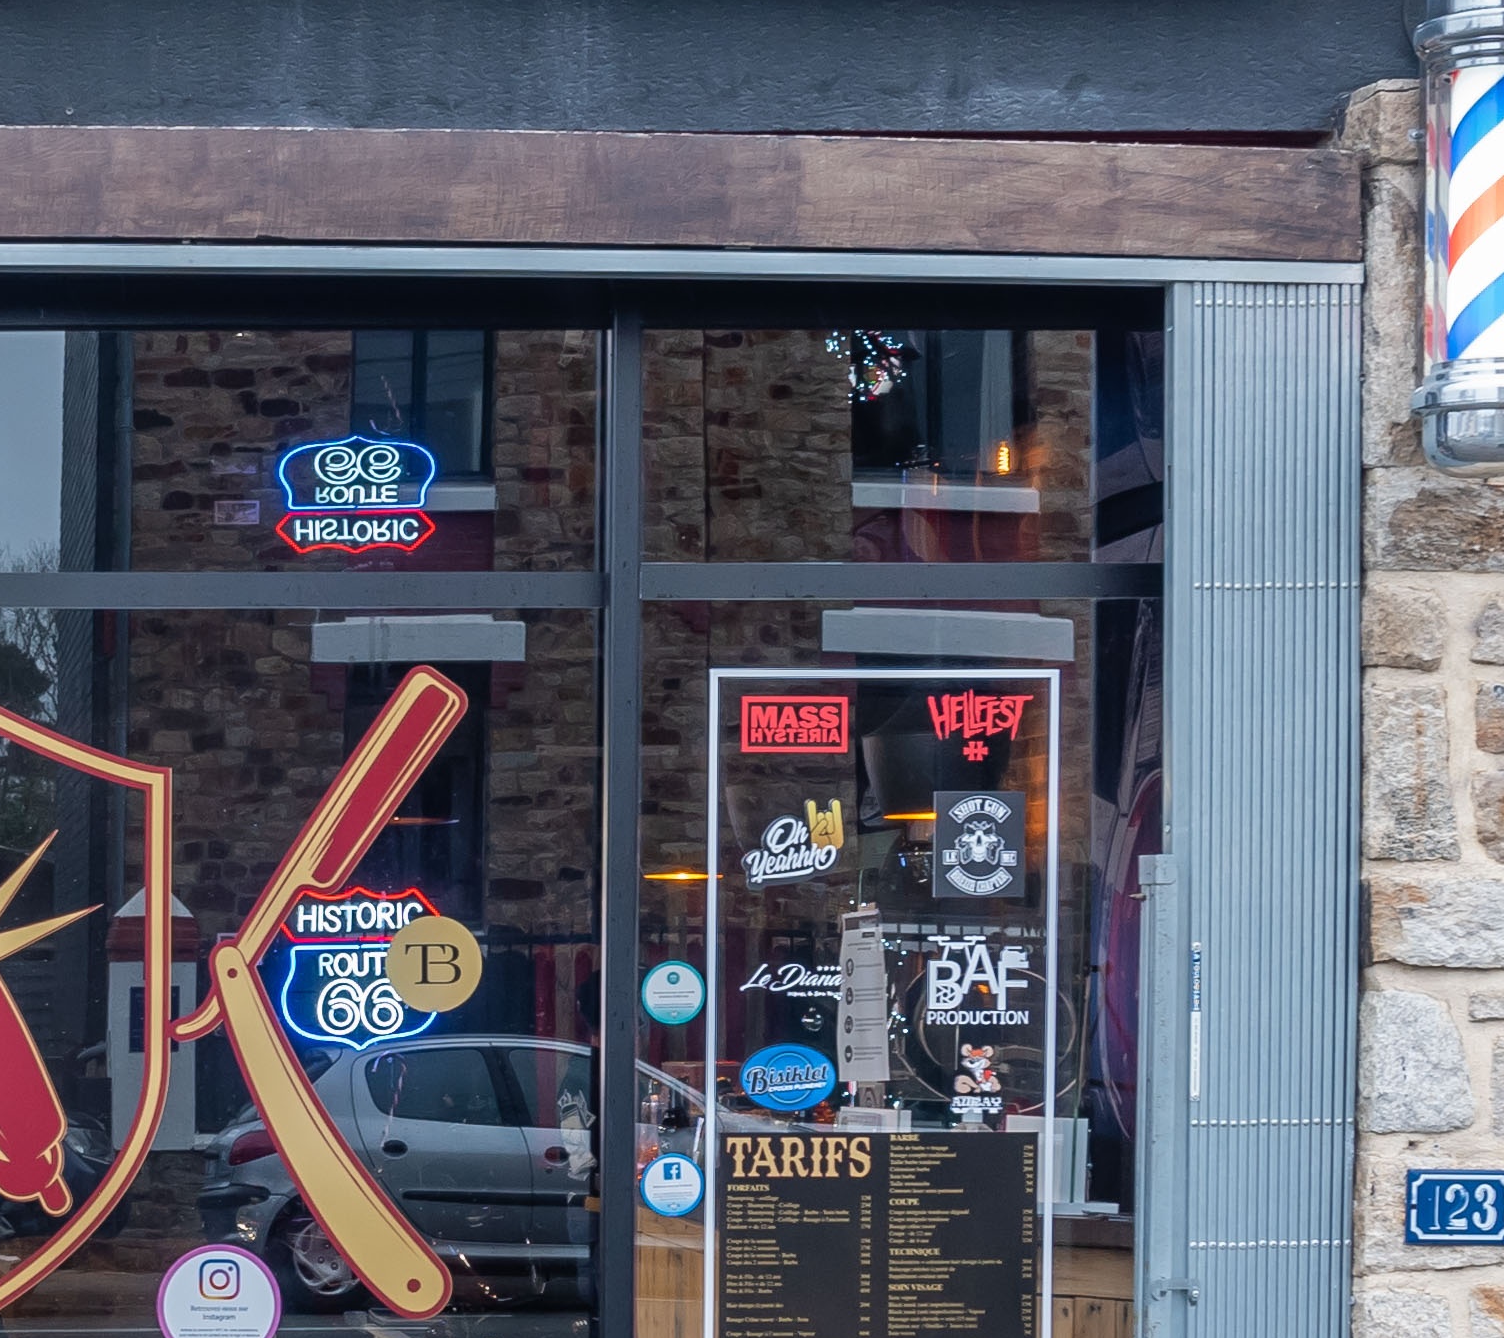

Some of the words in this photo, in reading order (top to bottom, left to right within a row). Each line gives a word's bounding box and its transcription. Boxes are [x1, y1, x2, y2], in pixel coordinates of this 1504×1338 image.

[751, 705, 840, 728] MASS
[927, 689, 1034, 741] HELLFEST
[766, 817, 809, 853] Oh
[296, 901, 424, 933] HISTORIC
[318, 952, 388, 977] ROUT
[739, 963, 773, 992] Le
[769, 963, 843, 992] Diana
[927, 943, 1030, 1011] BAF
[316, 977, 405, 1036] 66
[926, 1010, 1030, 1025] PRODUCTION
[726, 1136, 872, 1178] TARIFS
[1429, 1183, 1498, 1232] 123
